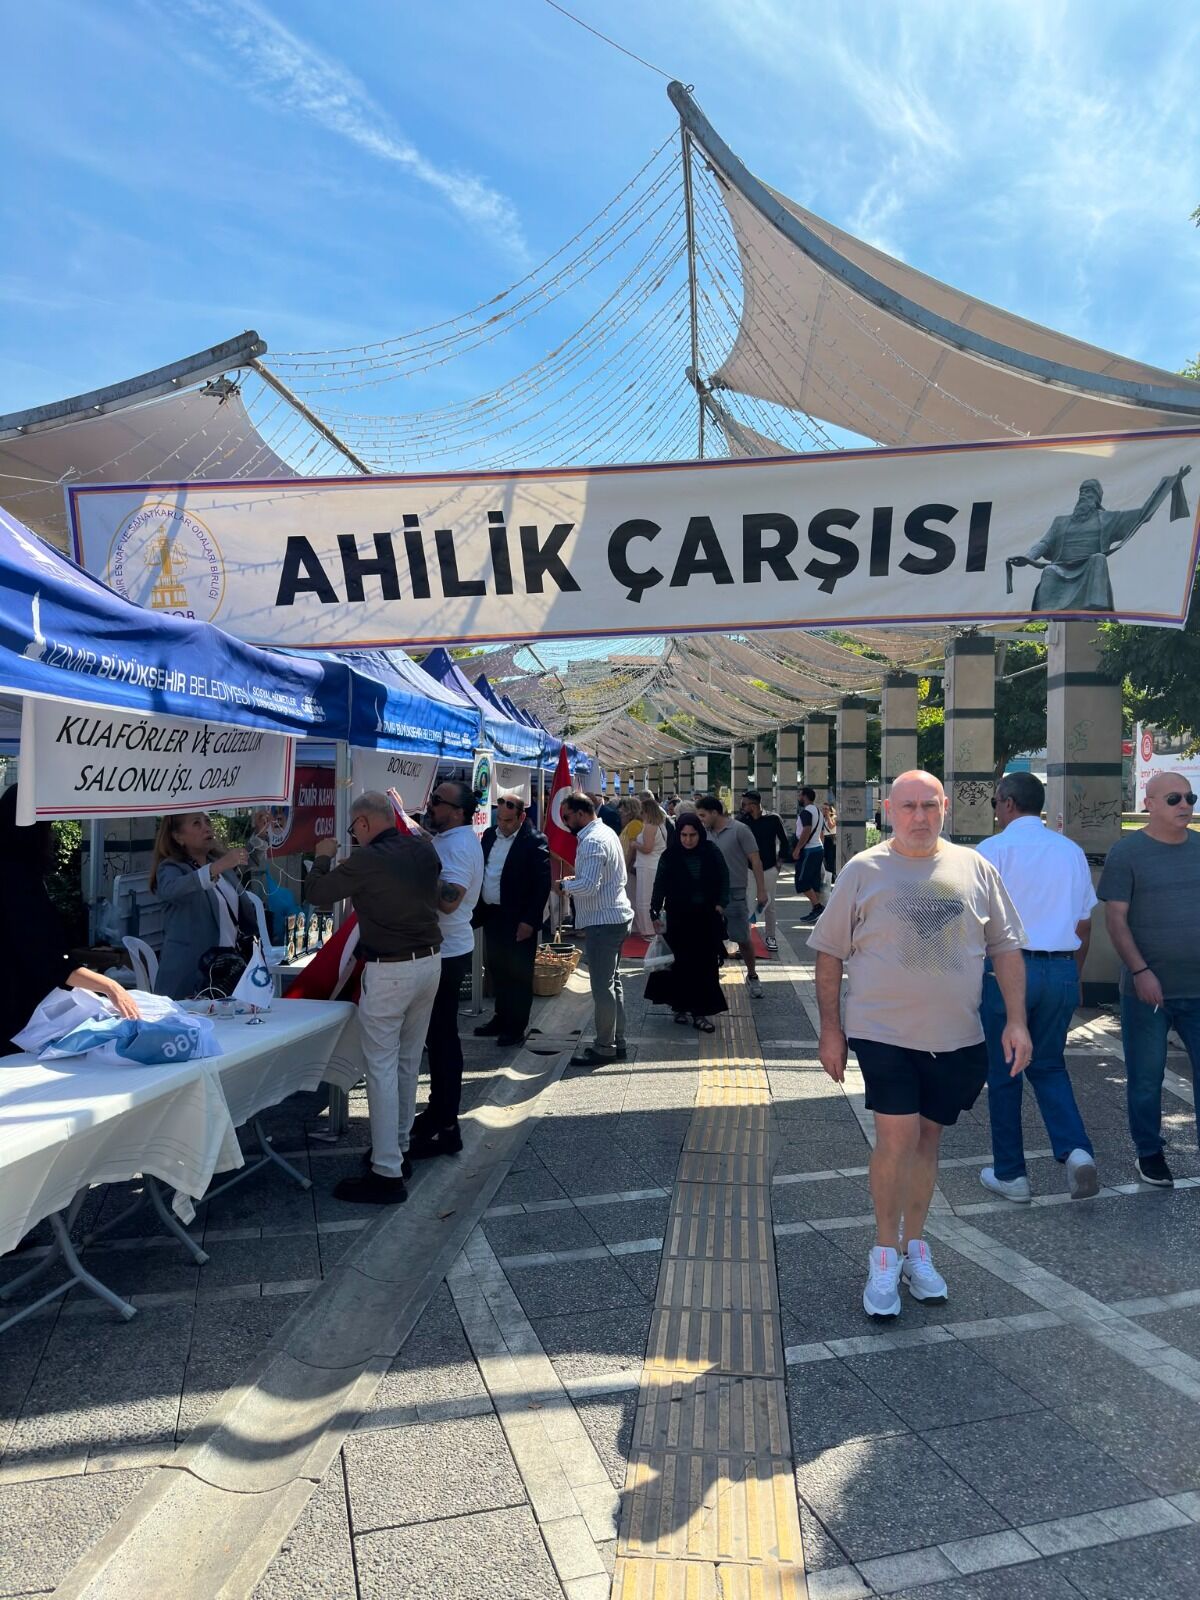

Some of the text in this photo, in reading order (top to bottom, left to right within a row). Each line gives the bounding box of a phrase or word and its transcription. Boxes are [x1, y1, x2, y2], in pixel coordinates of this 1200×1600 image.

[114, 544, 125, 577] ESNAF
[120, 530, 130, 544] VE
[191, 525, 217, 564] ODALARI
[275, 501, 992, 606] AHİLİK ÇARŞISI
[100, 654, 187, 693] BÜYÜKŞEHİR
[56, 715, 188, 753] KUAFÖRLER
[74, 763, 241, 797] SALONU İŞL. ODASI
